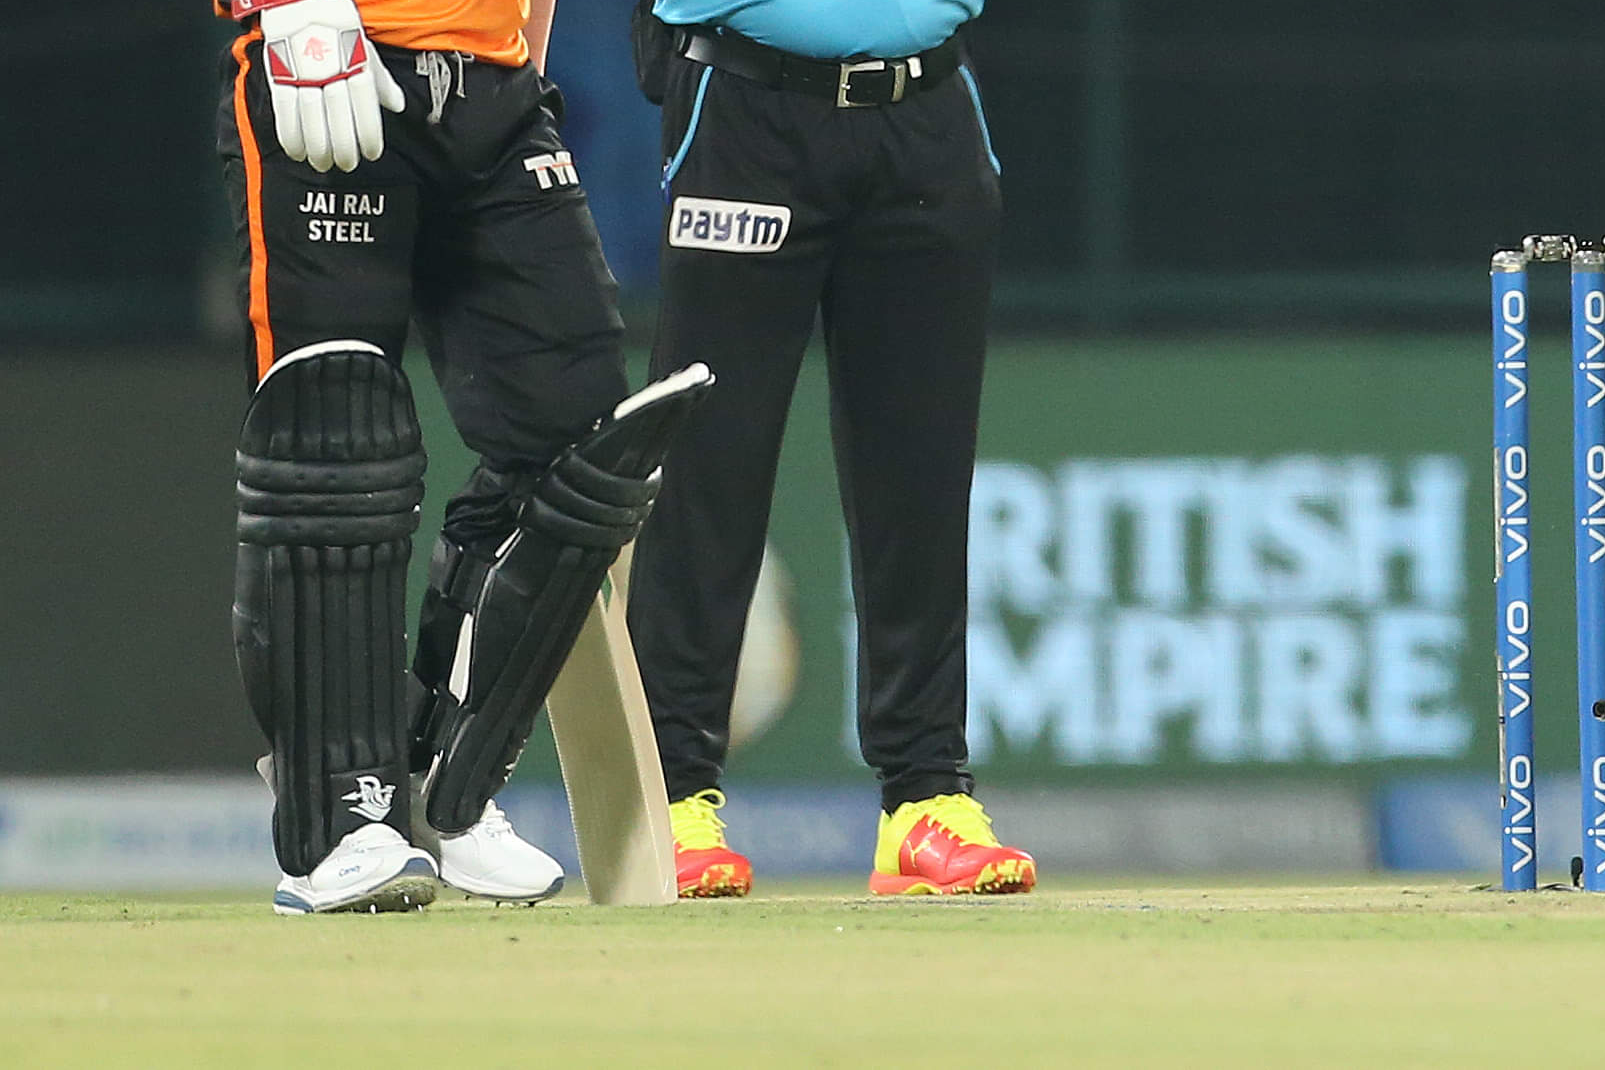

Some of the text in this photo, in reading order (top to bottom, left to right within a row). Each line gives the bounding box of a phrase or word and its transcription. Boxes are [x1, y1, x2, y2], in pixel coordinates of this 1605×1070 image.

[299, 192, 385, 216] JAI RAJ
[308, 219, 375, 243] STEEL
[676, 206, 784, 247] paytm
[1497, 290, 1527, 409] vivo
[967, 456, 1467, 612] RITISH
[1500, 445, 1529, 564] vivo
[966, 610, 1472, 764] MPIRE
[1502, 600, 1531, 719] vivo
[1504, 755, 1534, 874] vivo
